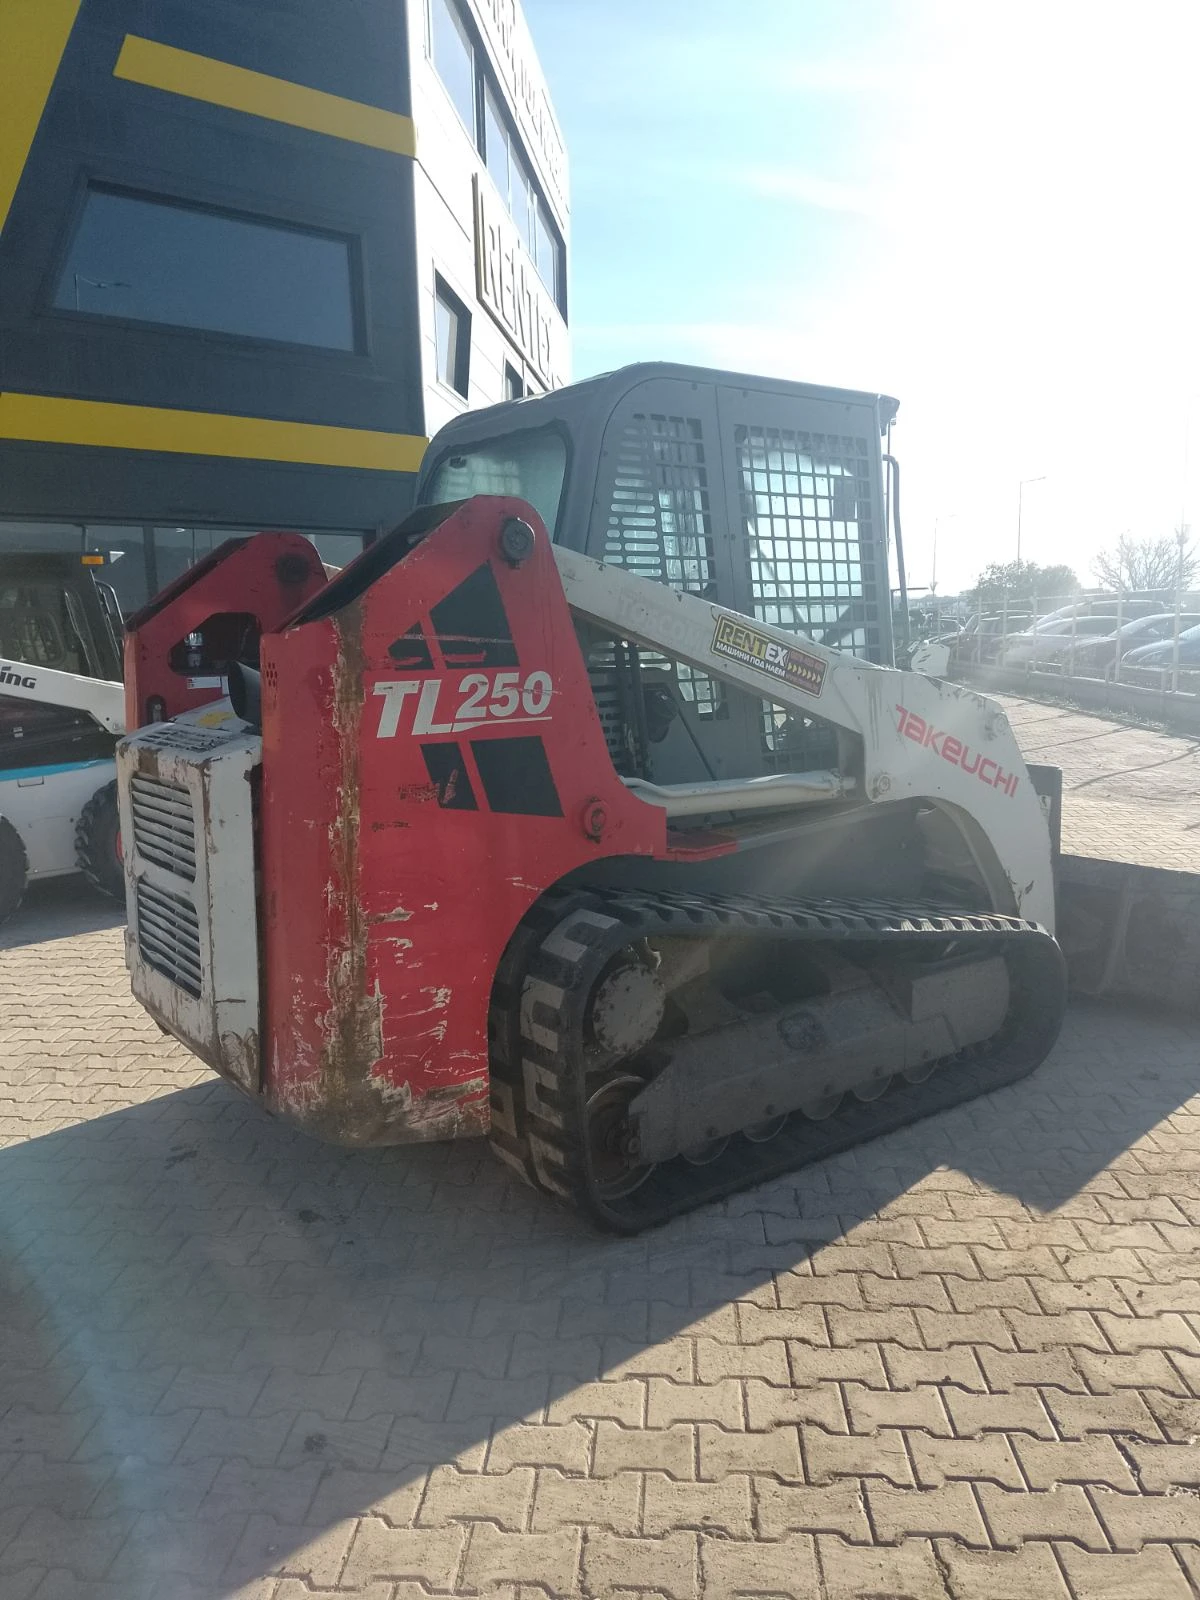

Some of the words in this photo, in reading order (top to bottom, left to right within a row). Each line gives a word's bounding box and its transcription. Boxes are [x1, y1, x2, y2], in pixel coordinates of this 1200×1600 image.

[715, 641, 750, 662] МАШИНИ
[750, 656, 765, 669] ПОД
[765, 663, 786, 678] НАЕМ
[719, 621, 788, 667] RENTEX
[373, 679, 453, 738] TL
[455, 671, 552, 718] 250
